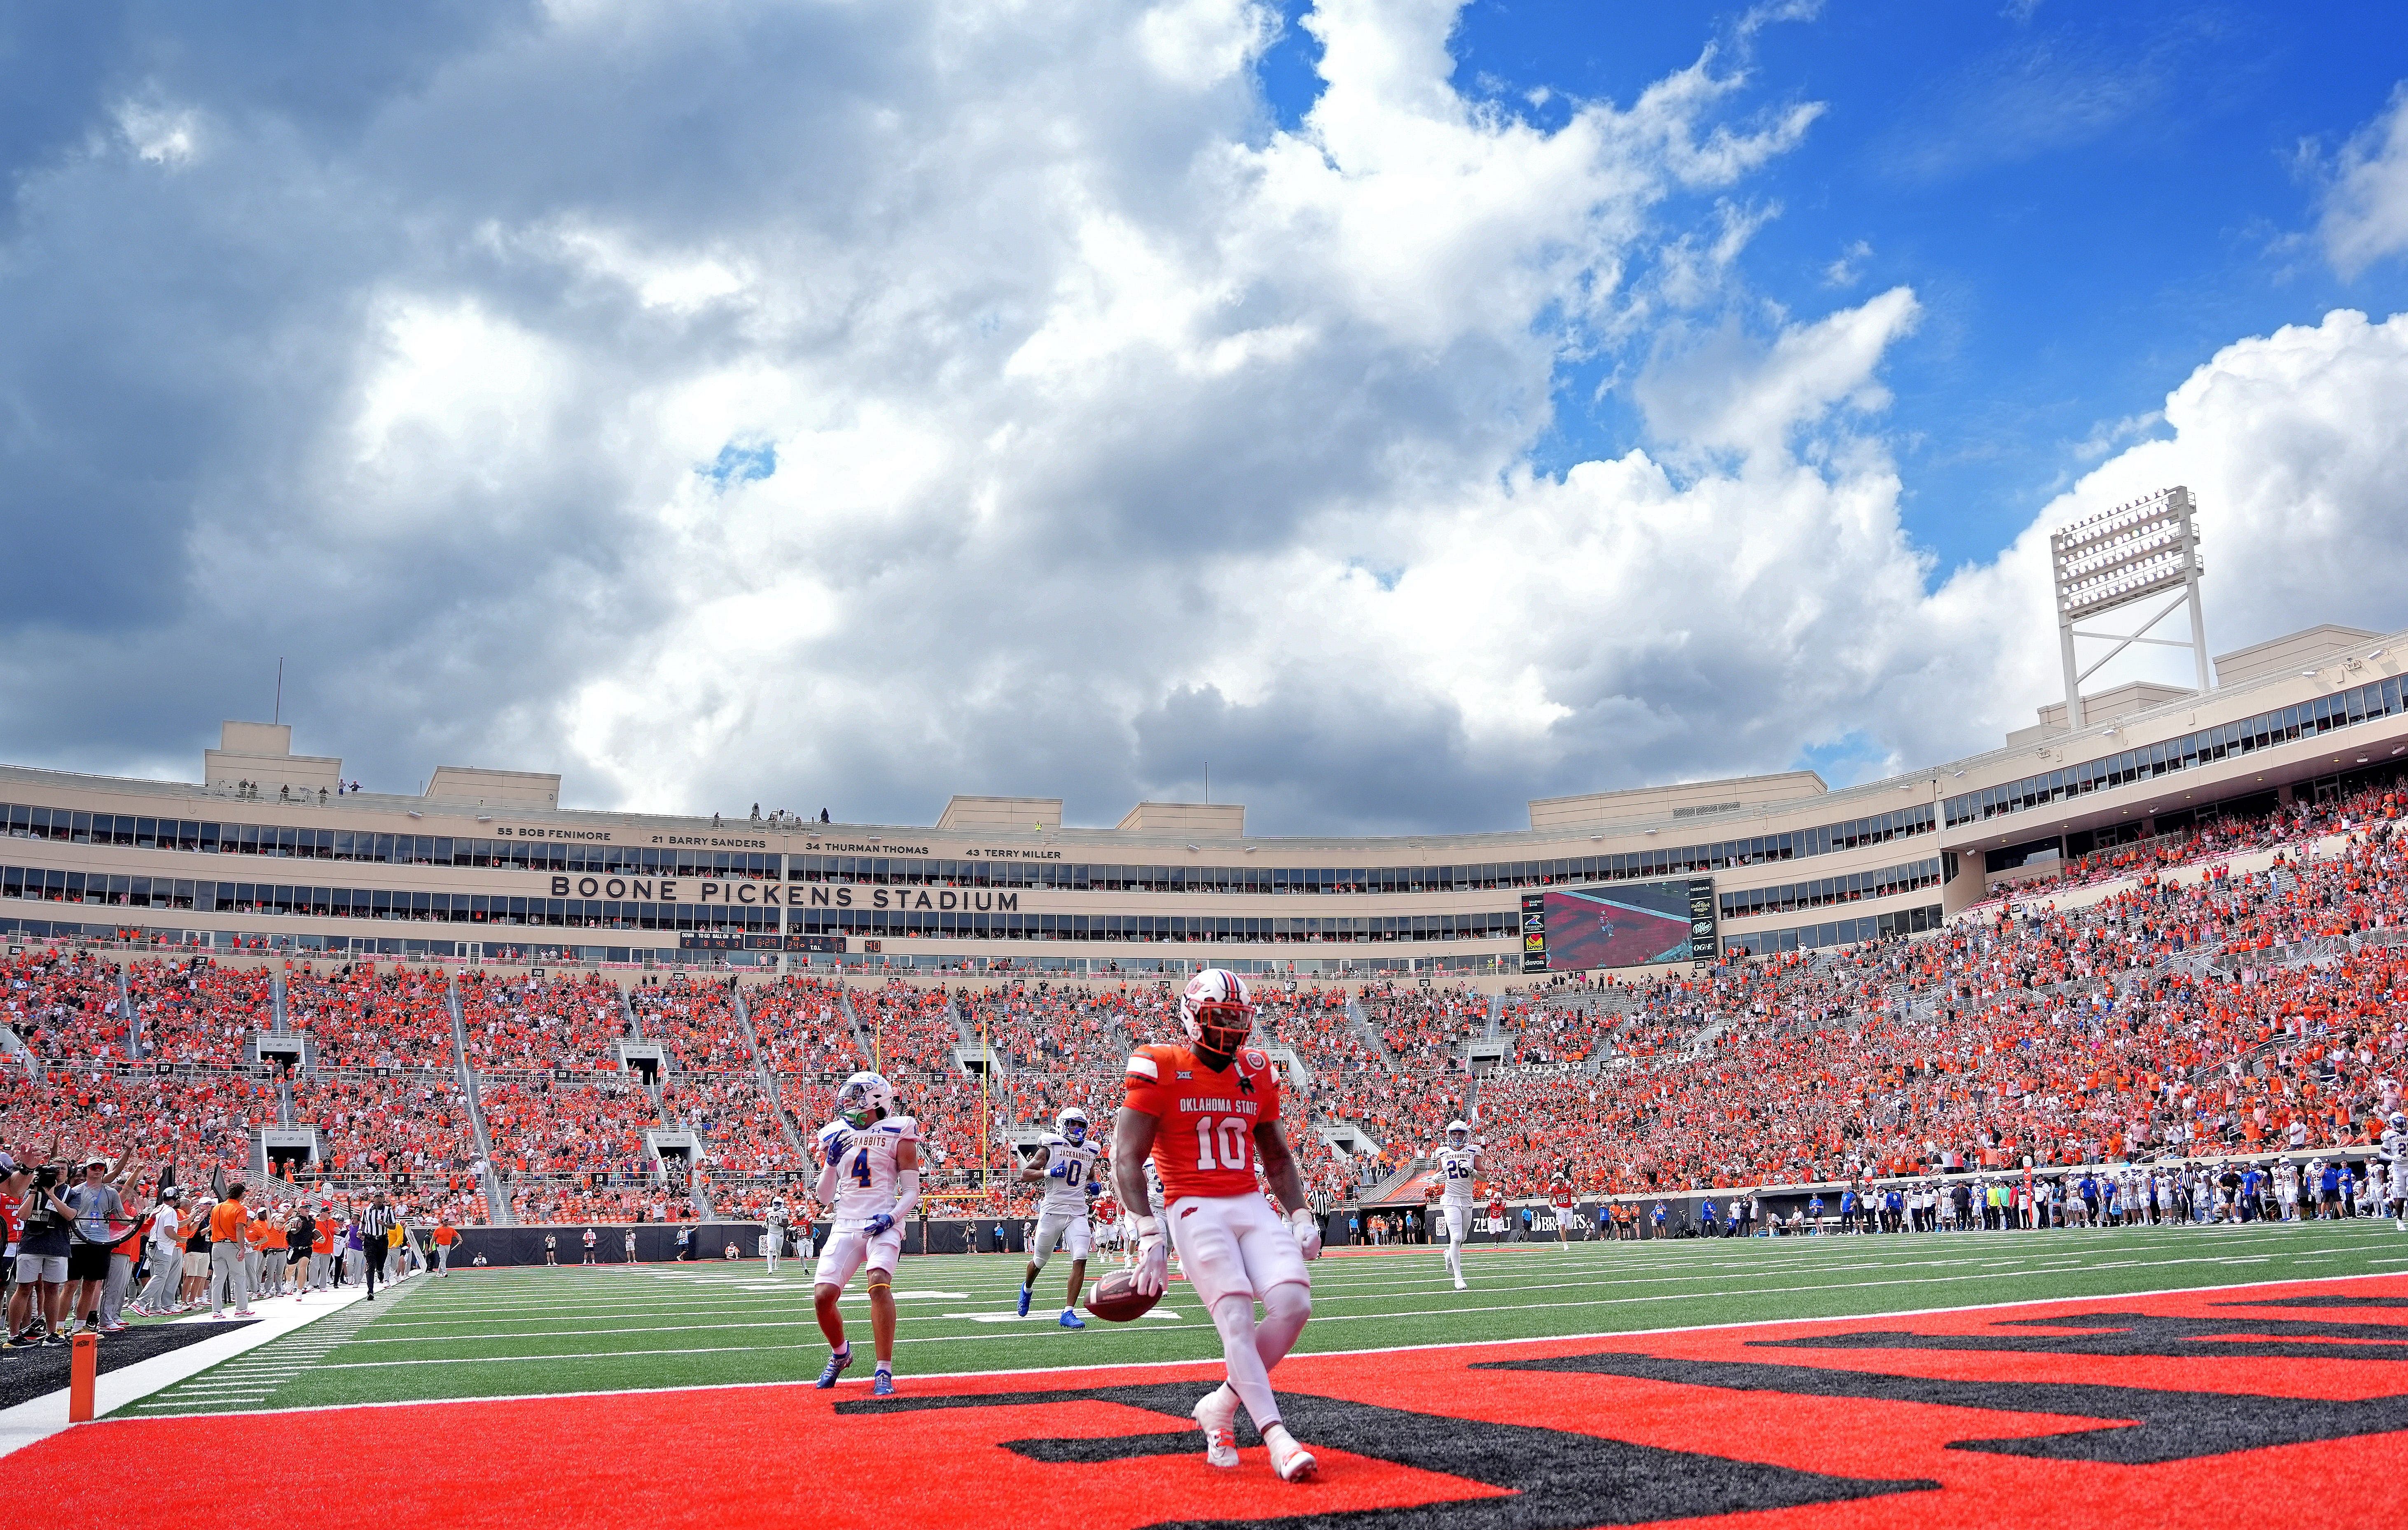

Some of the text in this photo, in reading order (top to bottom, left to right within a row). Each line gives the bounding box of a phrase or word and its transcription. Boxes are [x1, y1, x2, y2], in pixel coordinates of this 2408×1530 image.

[519, 828, 545, 837] BOB
[549, 829, 610, 841] FENIMORE
[669, 836, 708, 846] BARRY
[711, 838, 766, 848] SANDERS
[825, 843, 879, 853] THURMAN
[883, 846, 928, 854] THOMAS
[984, 849, 1019, 857] TERRY
[1022, 850, 1061, 859] MILLER
[552, 876, 1017, 911] BOONE PICKENS STADIUM
[1695, 923, 1711, 934] Pepper
[757, 938, 776, 947] 6:29
[787, 941, 799, 949] 24
[866, 941, 880, 951] 40
[1180, 1098, 1258, 1116] OKLAHOMA STATE
[853, 1137, 886, 1146] RABBITS
[1196, 1116, 1248, 1170] 10
[1059, 1149, 1090, 1161] JACKRABBITS
[851, 1147, 872, 1188] 4
[1066, 1159, 1082, 1187] 0
[1447, 1159, 1469, 1180] 26
[1851, 1174, 1857, 1184] 2
[12, 1210, 25, 1231] 3
[1541, 1216, 1585, 1232] BRAM'S
